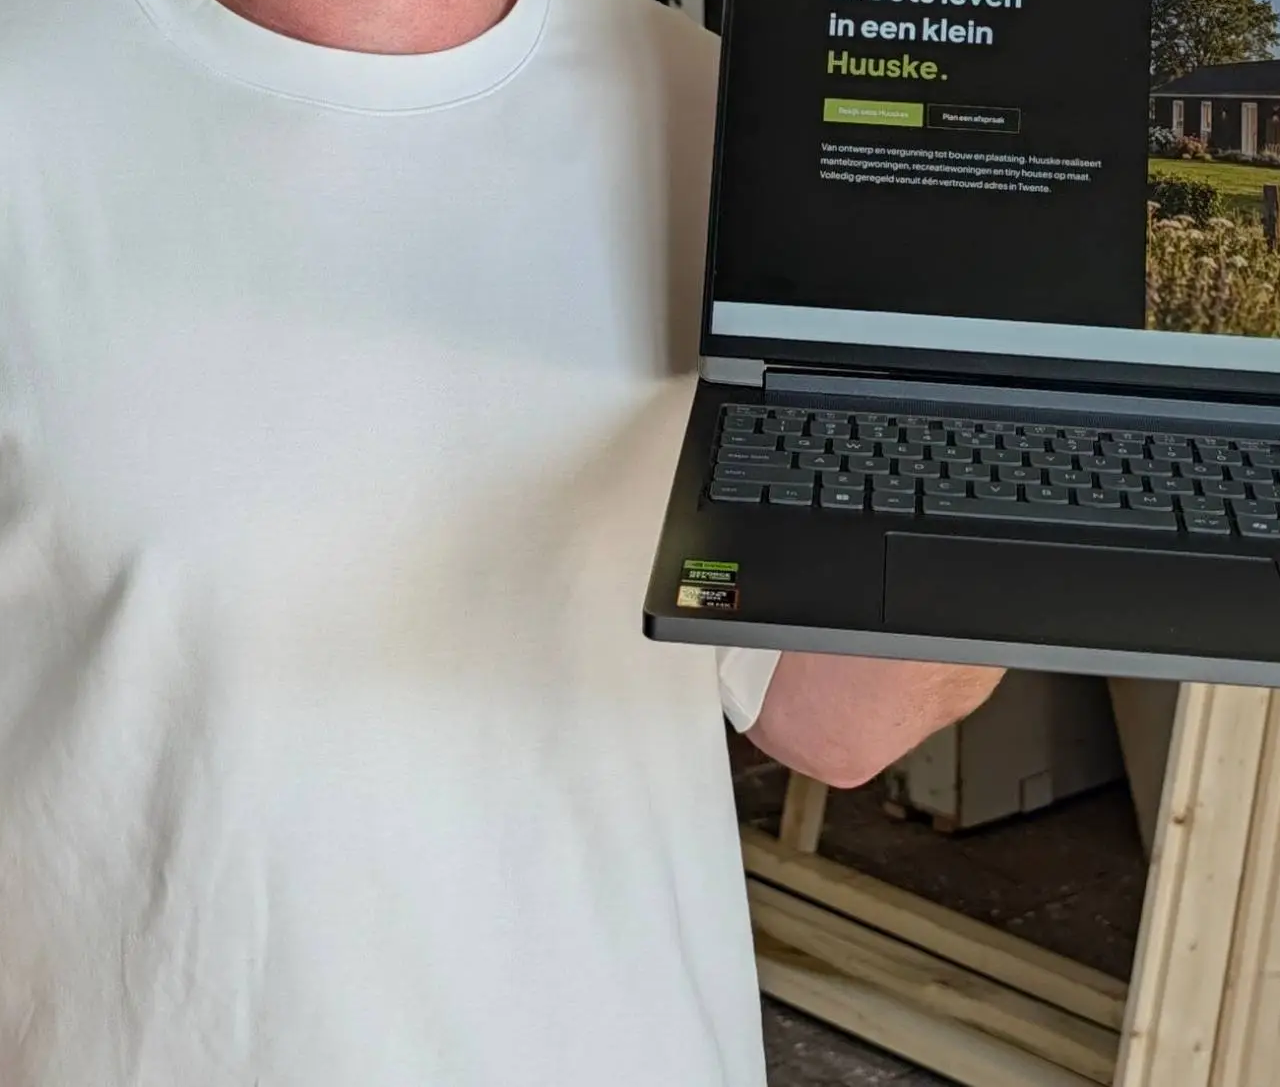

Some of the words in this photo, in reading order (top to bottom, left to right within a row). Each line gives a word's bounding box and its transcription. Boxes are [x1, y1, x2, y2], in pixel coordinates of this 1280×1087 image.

[828, 12, 854, 38] in
[860, 19, 917, 42] een
[922, 17, 994, 46] klein
[826, 49, 949, 82] Huuske.
[821, 142, 838, 152] Van
[838, 144, 874, 156] ontwerp
[874, 147, 886, 155] en
[886, 147, 934, 160] vergunning
[934, 150, 948, 158] tot
[948, 150, 974, 160] bouw
[974, 153, 985, 161] en
[1028, 155, 1061, 165] Huuske
[820, 156, 912, 171] mantelzorgwoningen,
[912, 163, 992, 176] recreatiewoningen
[1004, 168, 1021, 178] tiny
[1021, 168, 1052, 179] houses
[1053, 171, 1066, 181] op
[820, 170, 855, 182] Volledig
[855, 173, 894, 184] geregeld
[895, 175, 921, 185] vanuit
[939, 178, 983, 189] vertrouwd
[983, 180, 1008, 191] adres
[1008, 182, 1017, 191] in
[1017, 182, 1052, 193] Twente.
